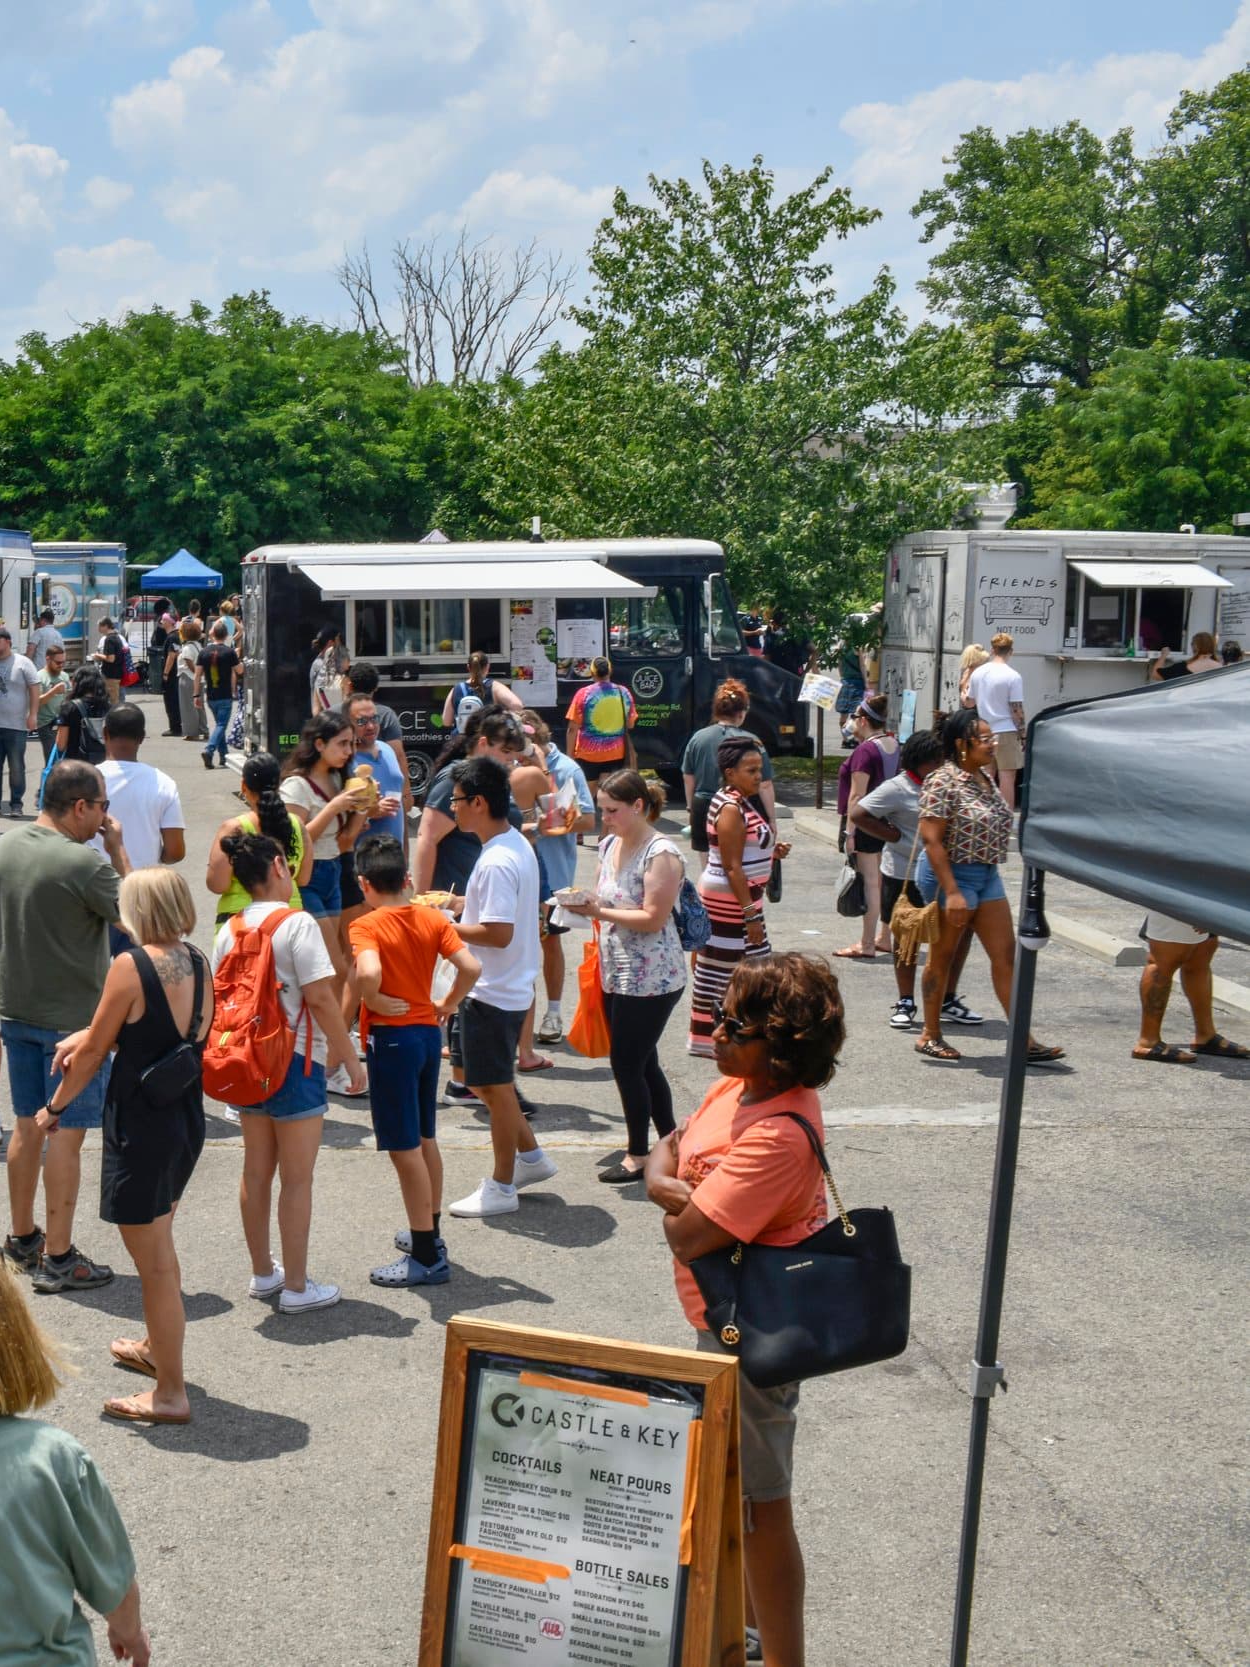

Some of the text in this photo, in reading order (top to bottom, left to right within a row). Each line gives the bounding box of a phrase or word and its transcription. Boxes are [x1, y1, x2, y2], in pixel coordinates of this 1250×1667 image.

[979, 576, 1058, 590] FRIENDS
[996, 626, 1036, 634] NOT FOOD
[402, 733, 443, 741] moothies
[531, 1406, 614, 1438] CASTLE
[620, 1424, 630, 1439] &
[637, 1425, 680, 1449] KEY
[492, 1451, 562, 1474] COCKTAILS
[508, 1479, 538, 1490] WHISKEY
[589, 1468, 672, 1495] NEAT POURS
[482, 1498, 516, 1509] LAVENDER
[480, 1520, 524, 1534] RESTORATION
[575, 1559, 623, 1580] BOTTLE
[627, 1570, 670, 1589] SALES
[474, 1577, 507, 1590] KENTUCKY
[509, 1584, 547, 1597] PAINKILLER
[470, 1623, 493, 1634] CASTLE
[495, 1629, 520, 1640] CLOVER
